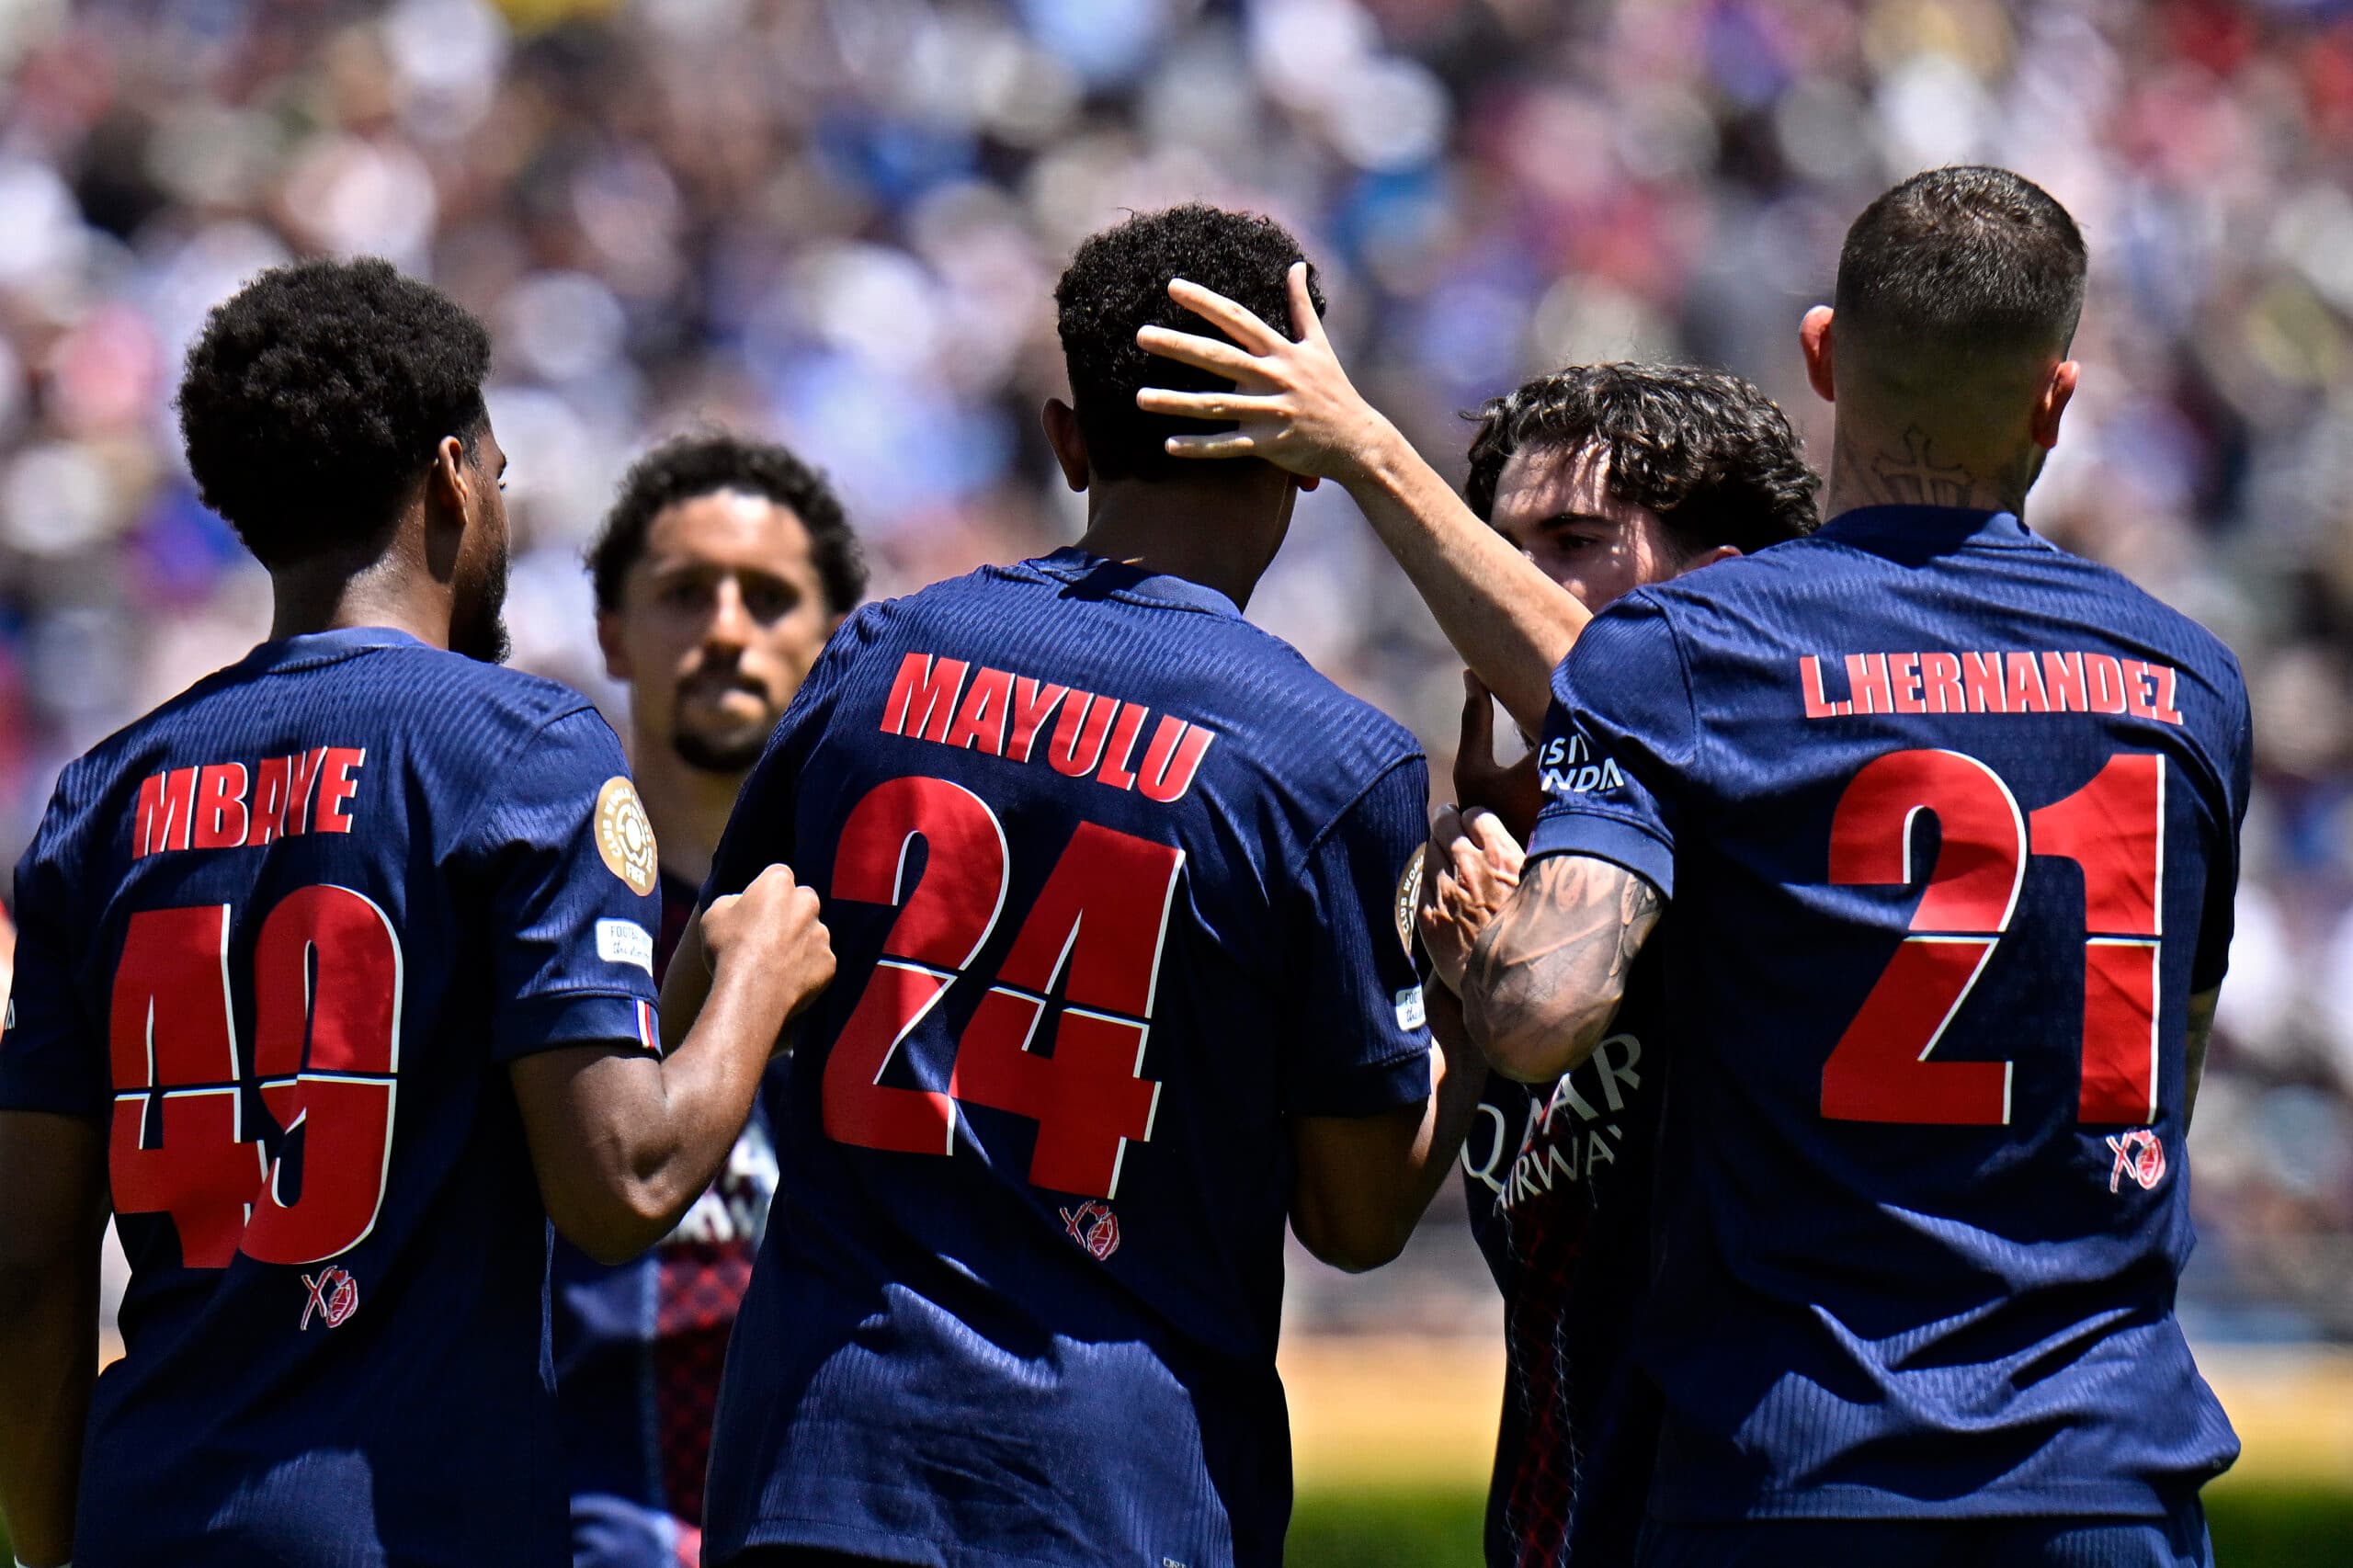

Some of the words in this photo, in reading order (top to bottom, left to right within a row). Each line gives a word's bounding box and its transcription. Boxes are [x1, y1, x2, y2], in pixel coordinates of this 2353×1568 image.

[879, 653, 1216, 803] MAYULU
[1798, 651, 2184, 726] L.HERNANDEZ
[132, 745, 367, 860] MBAYE
[822, 775, 1187, 1200] 24
[1400, 896, 1411, 935] CLUB
[1819, 748, 2166, 1126] 21
[108, 883, 404, 1269] 49
